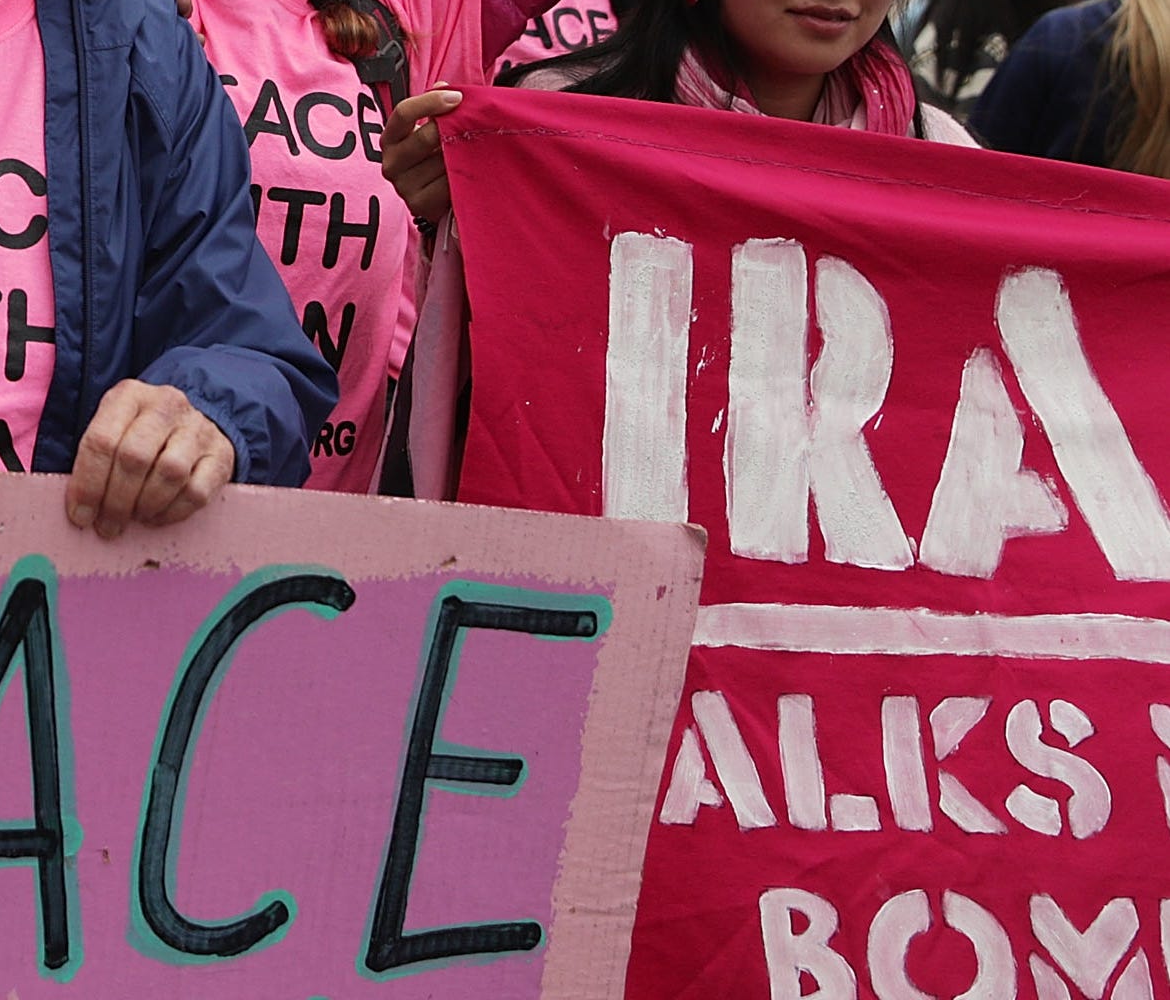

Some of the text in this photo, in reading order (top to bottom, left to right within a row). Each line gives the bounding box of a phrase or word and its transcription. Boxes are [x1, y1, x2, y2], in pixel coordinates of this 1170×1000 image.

[219, 75, 384, 164] ACE
[659, 689, 1114, 841] ALKS
[758, 886, 1170, 1000] BOM
